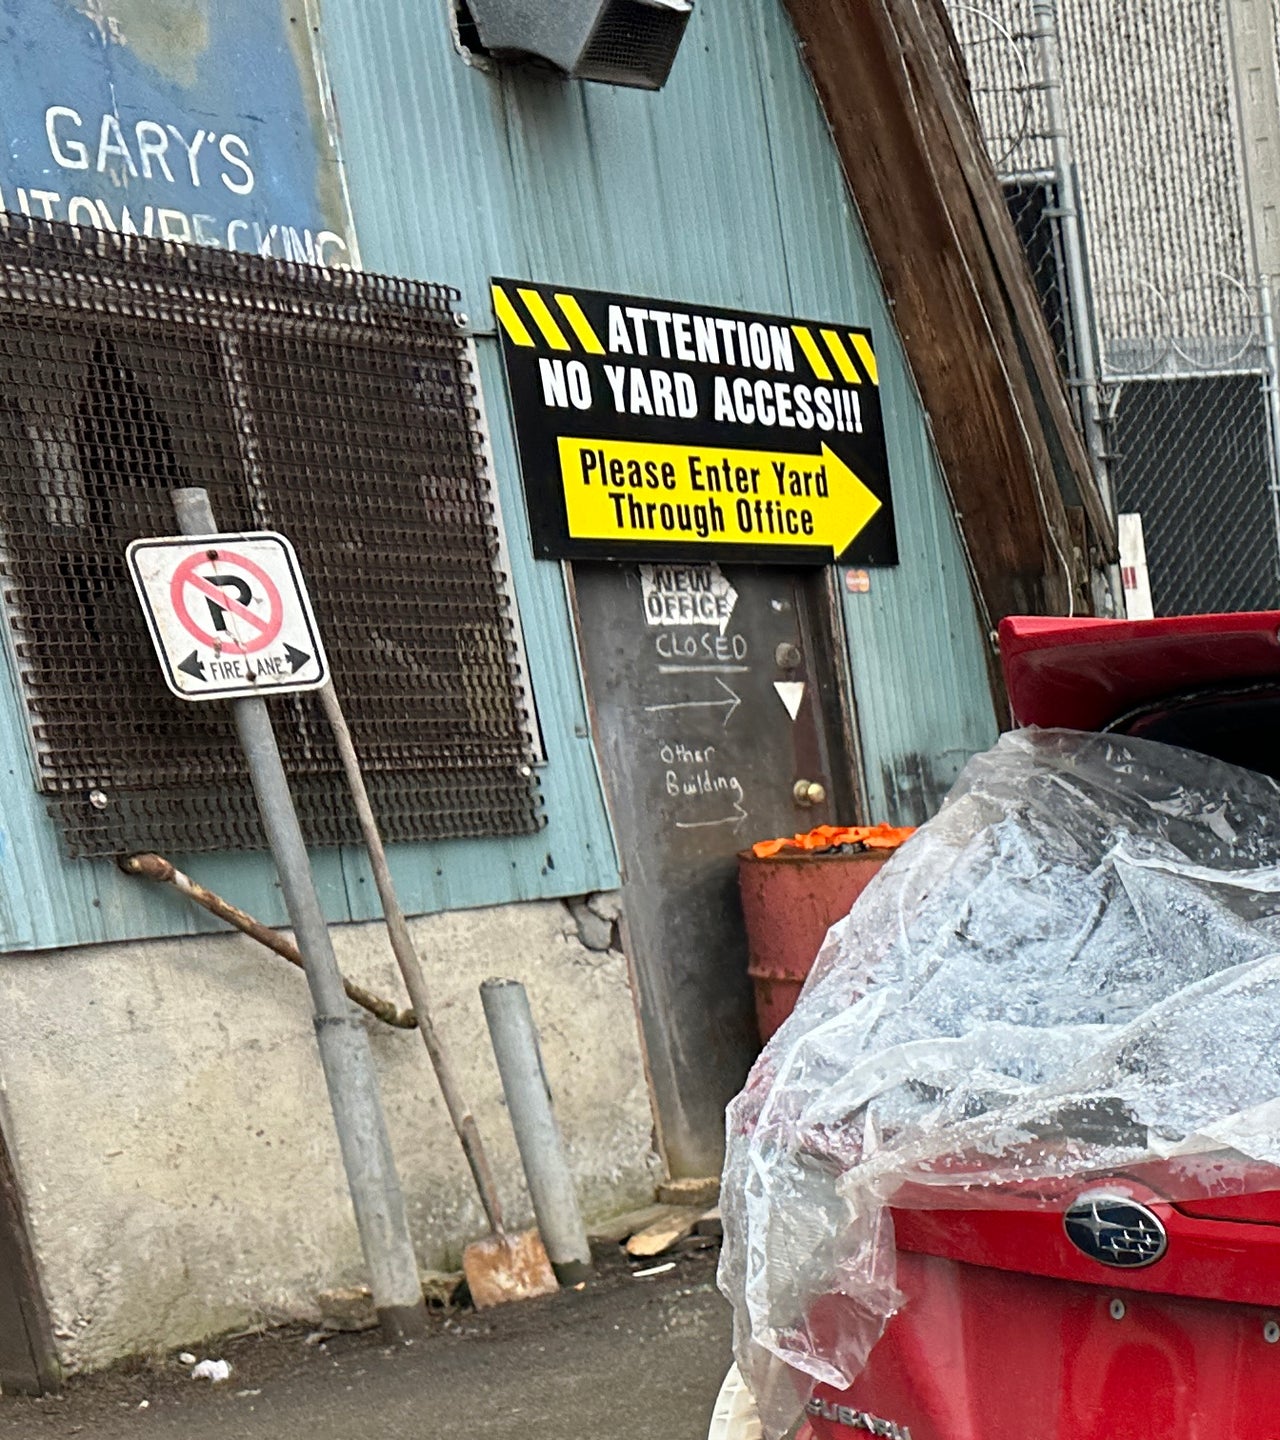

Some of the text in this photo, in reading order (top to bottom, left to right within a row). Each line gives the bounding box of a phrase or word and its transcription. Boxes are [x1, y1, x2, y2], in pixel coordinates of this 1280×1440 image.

[46, 105, 254, 194] GARY'S
[608, 304, 794, 373] ATTENTION
[538, 358, 863, 434] NO YARD ACCESS!!!
[579, 448, 829, 498] Please Enter Yard
[608, 492, 814, 538] Through Office
[653, 566, 712, 592] NEW
[655, 632, 748, 660] CLOSED
[210, 656, 284, 681] FIRE LANE
[660, 743, 716, 764] Other
[665, 769, 744, 804] Building
